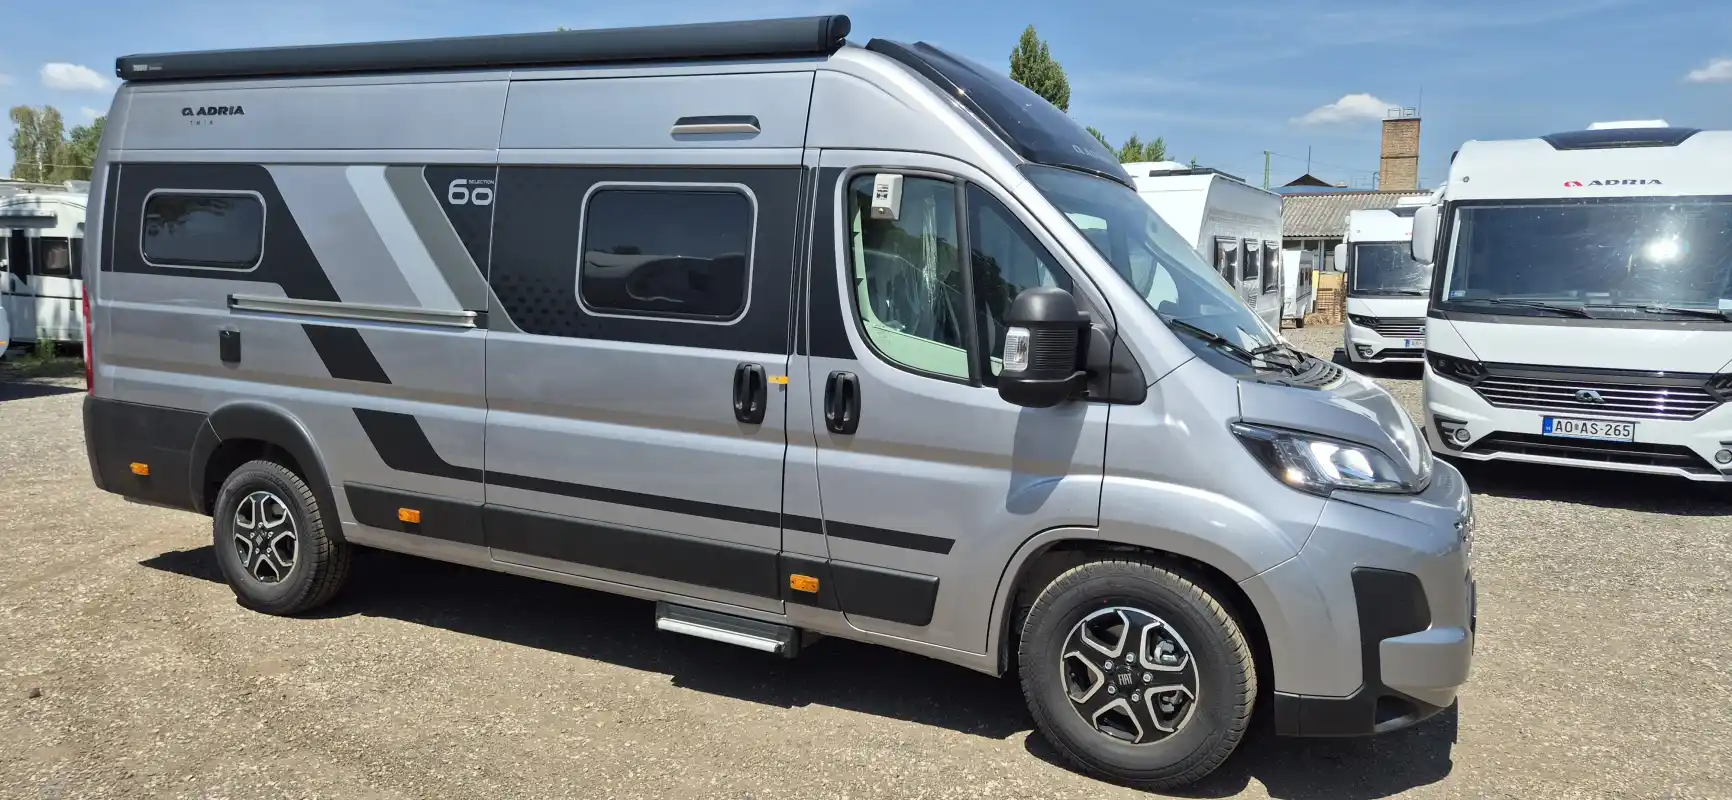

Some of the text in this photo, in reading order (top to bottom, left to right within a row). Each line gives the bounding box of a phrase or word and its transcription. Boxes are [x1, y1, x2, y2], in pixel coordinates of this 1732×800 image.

[197, 105, 245, 116] ADRIA
[448, 178, 493, 205] 60
[1580, 422, 1631, 437] AS-265
[1117, 673, 1133, 686] FIAT
